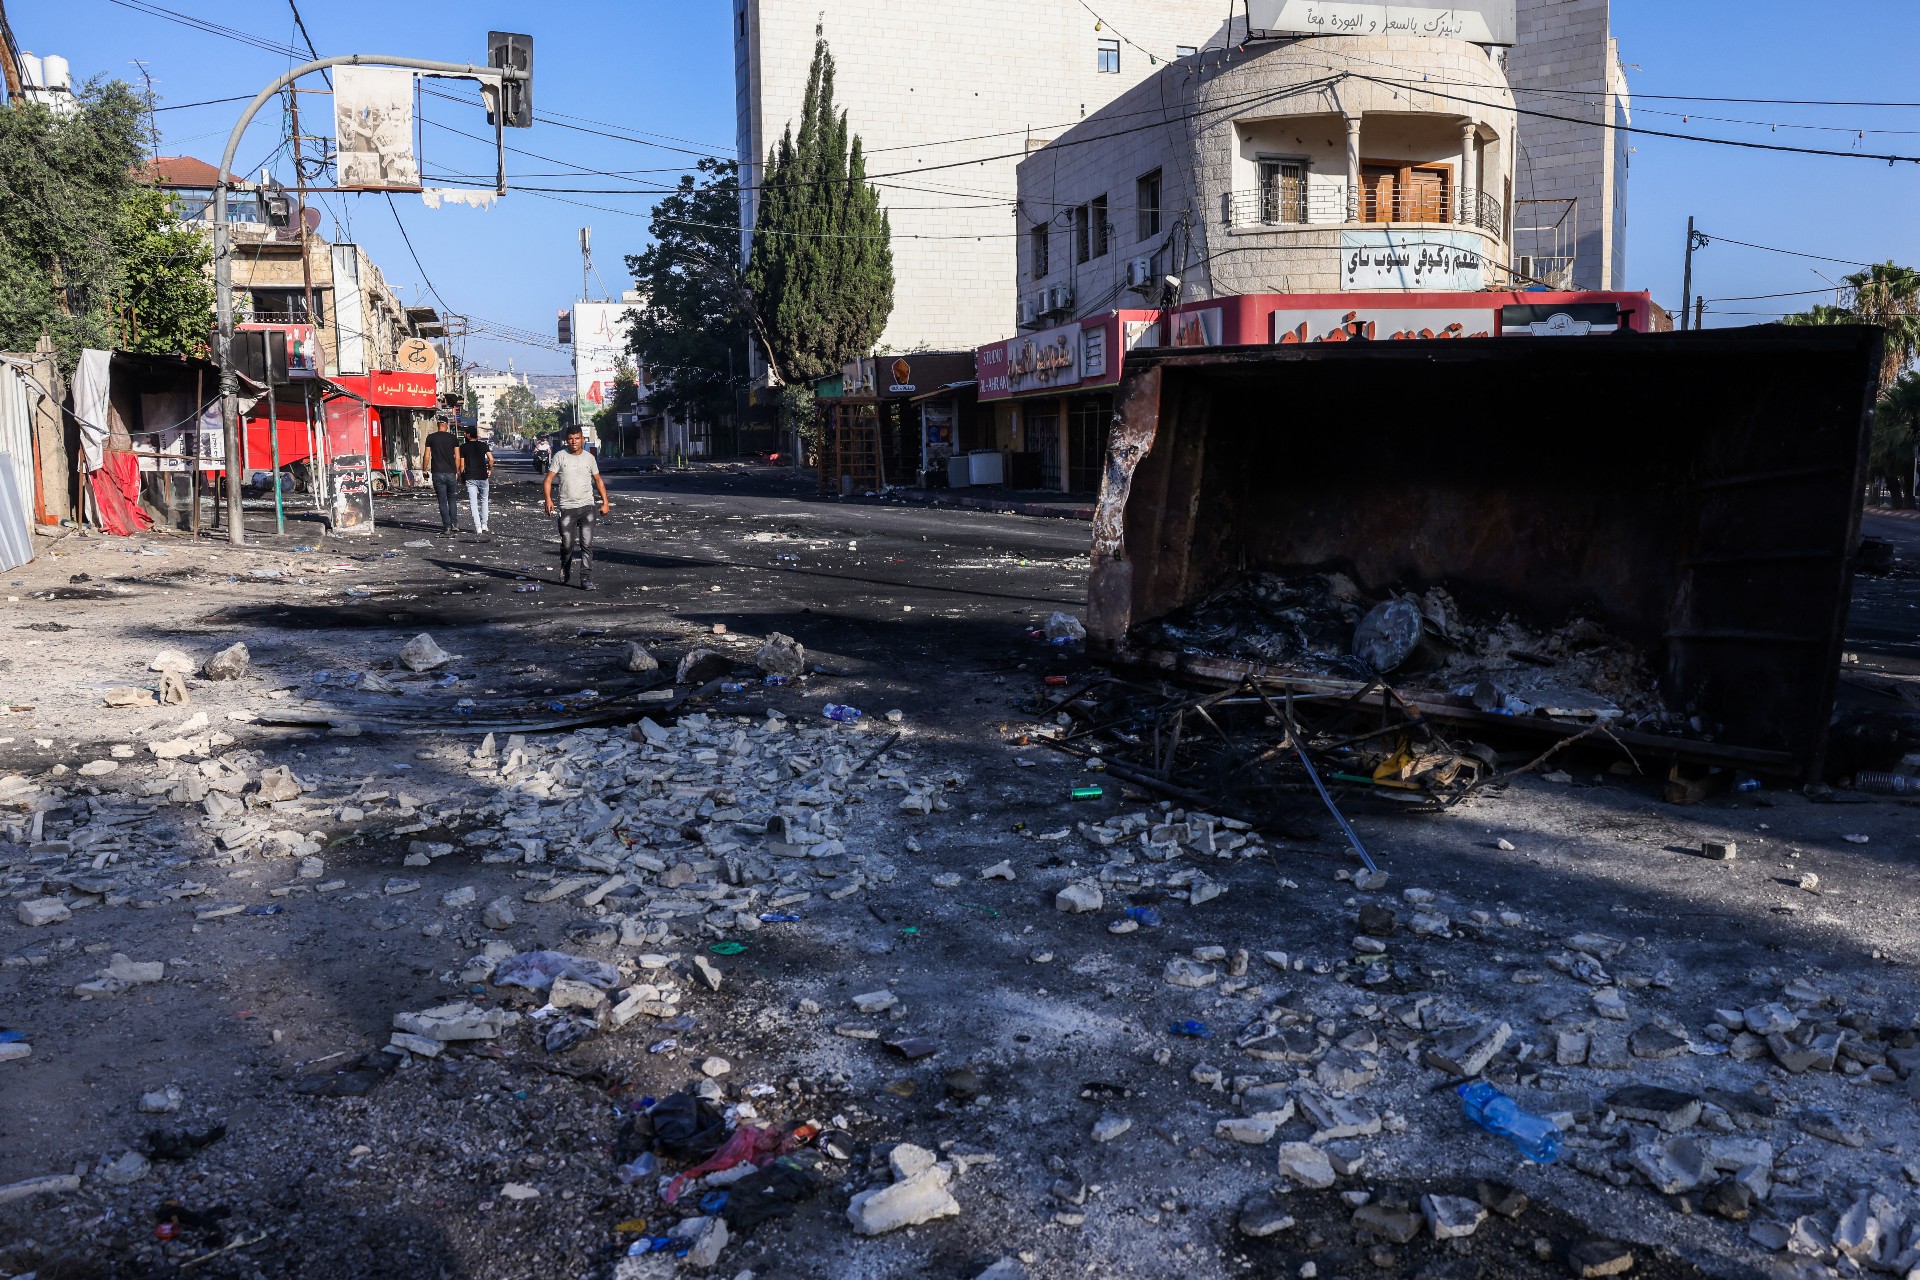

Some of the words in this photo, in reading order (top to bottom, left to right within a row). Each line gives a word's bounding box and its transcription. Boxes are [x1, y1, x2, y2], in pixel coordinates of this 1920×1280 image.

[1331, 13, 1363, 31] الجودة
[1369, 20, 1377, 32] و
[1382, 17, 1417, 34] بالسعر
[1424, 11, 1463, 37] نيزك
[1374, 237, 1410, 276] شوب
[983, 348, 1003, 366] STUDIO
[406, 383, 435, 396] صيدلية
